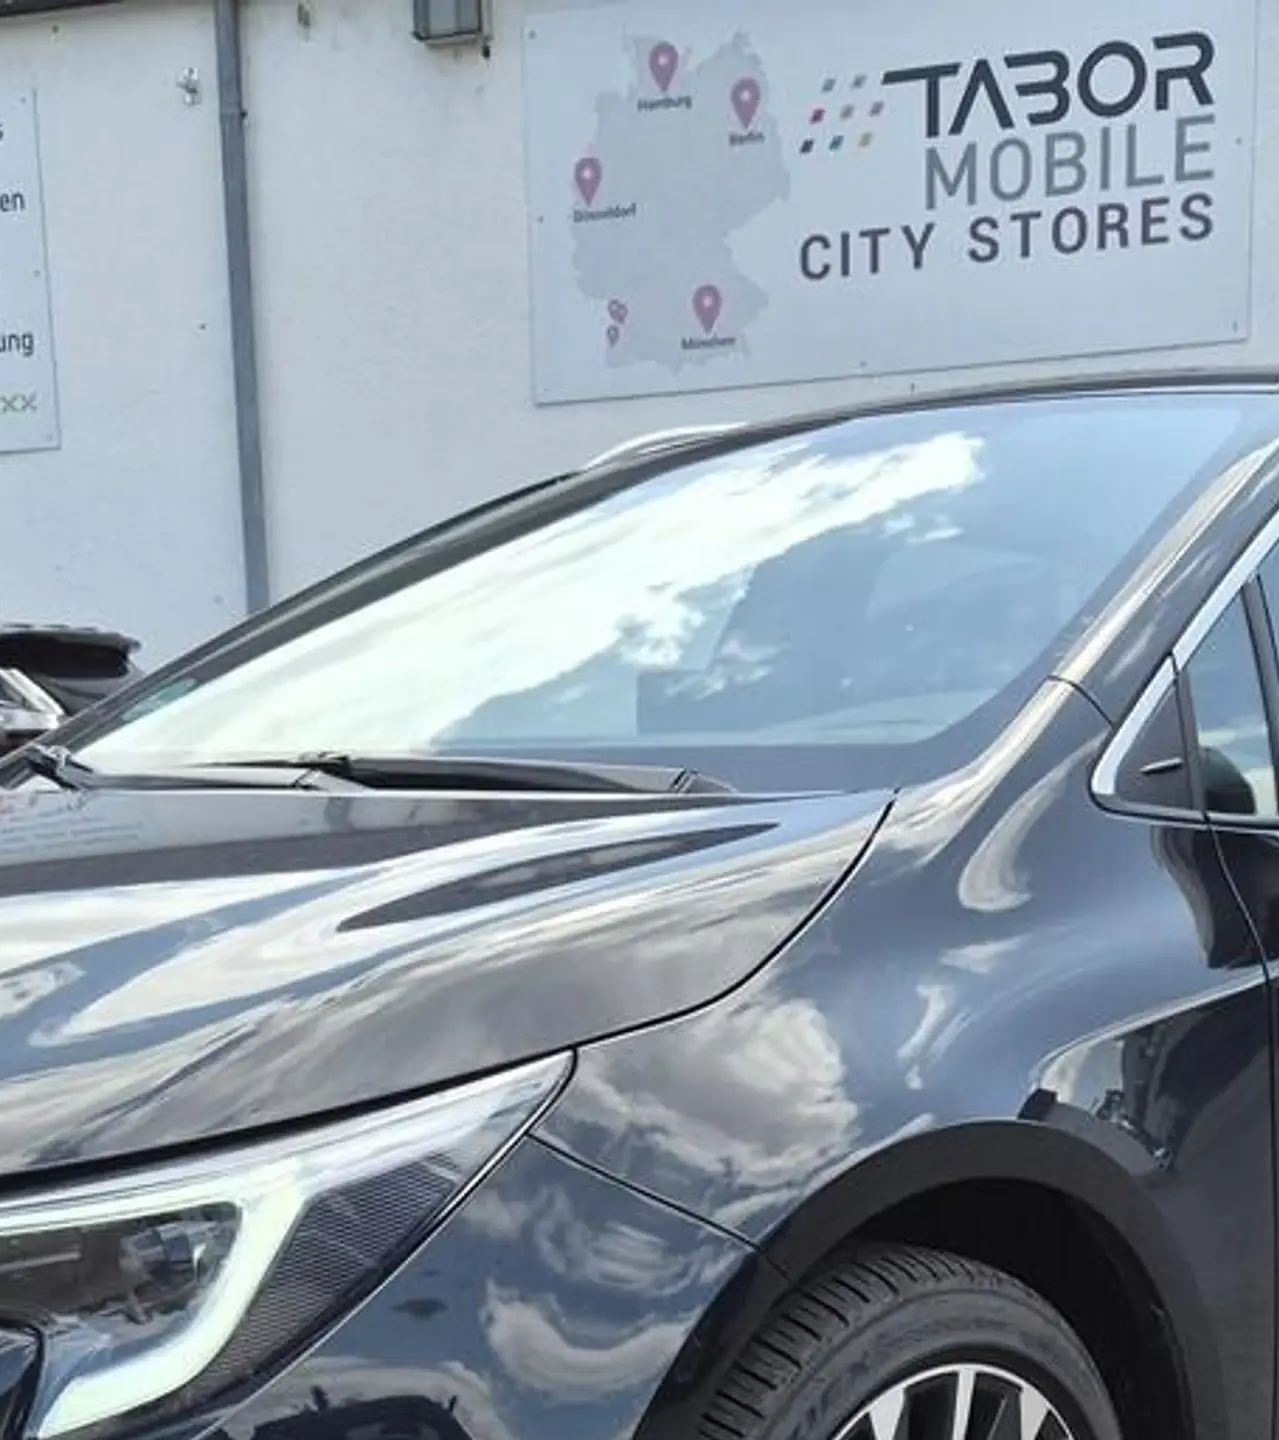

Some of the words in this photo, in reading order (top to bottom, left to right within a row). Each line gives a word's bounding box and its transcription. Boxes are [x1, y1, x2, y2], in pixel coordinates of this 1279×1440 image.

[881, 30, 1215, 139] TABOR
[925, 113, 1214, 210] MOBILE
[800, 222, 936, 282] CITY
[967, 193, 1214, 264] STORES
